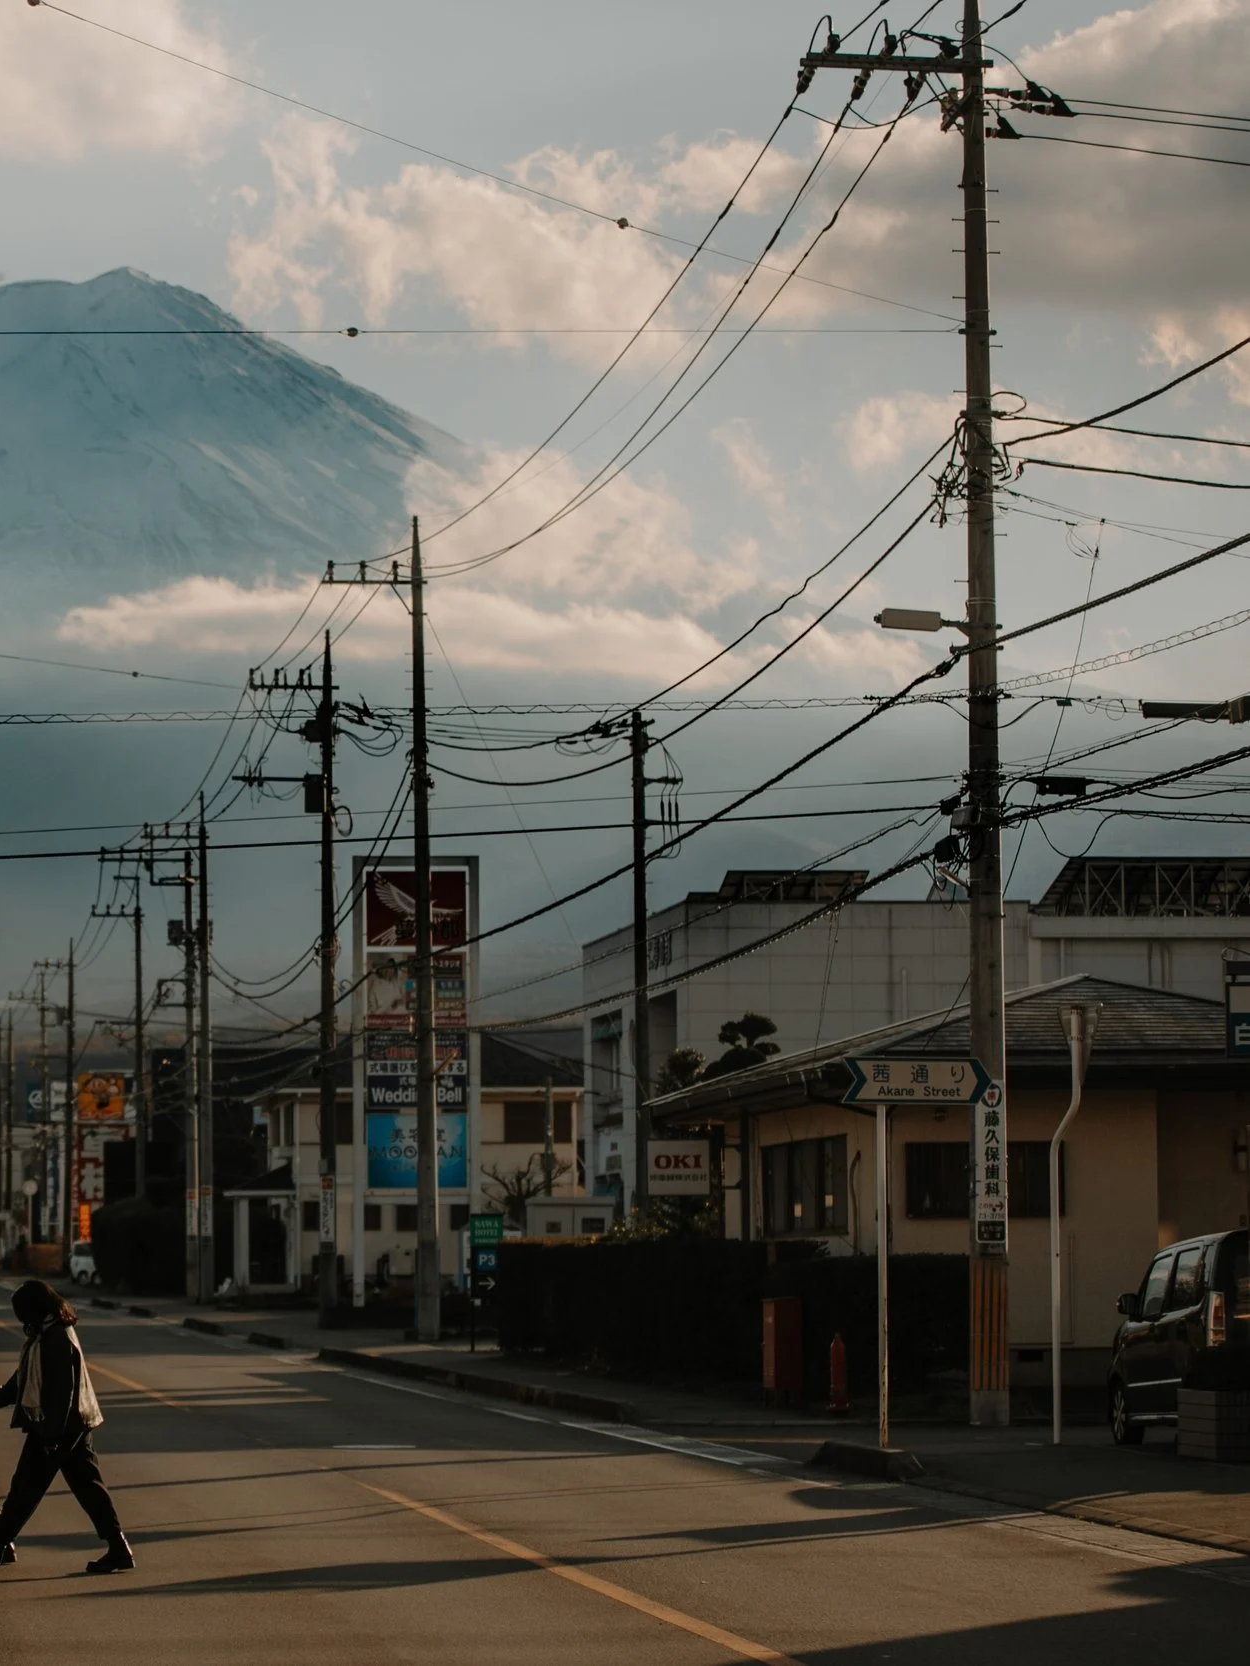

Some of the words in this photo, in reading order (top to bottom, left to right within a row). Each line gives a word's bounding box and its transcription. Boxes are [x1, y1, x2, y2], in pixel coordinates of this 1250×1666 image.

[871, 1064, 965, 1084] 茜通り
[371, 1087, 419, 1104] Weddi
[437, 1087, 462, 1103] Bell
[878, 1086, 915, 1097] Akane
[923, 1086, 961, 1097] Street
[369, 1146, 462, 1159] MOOAN
[984, 1110, 1000, 1196] 藤久保歯科
[654, 1154, 703, 1170] OKI
[475, 1220, 499, 1228] SAWA
[478, 1253, 495, 1266] P3
